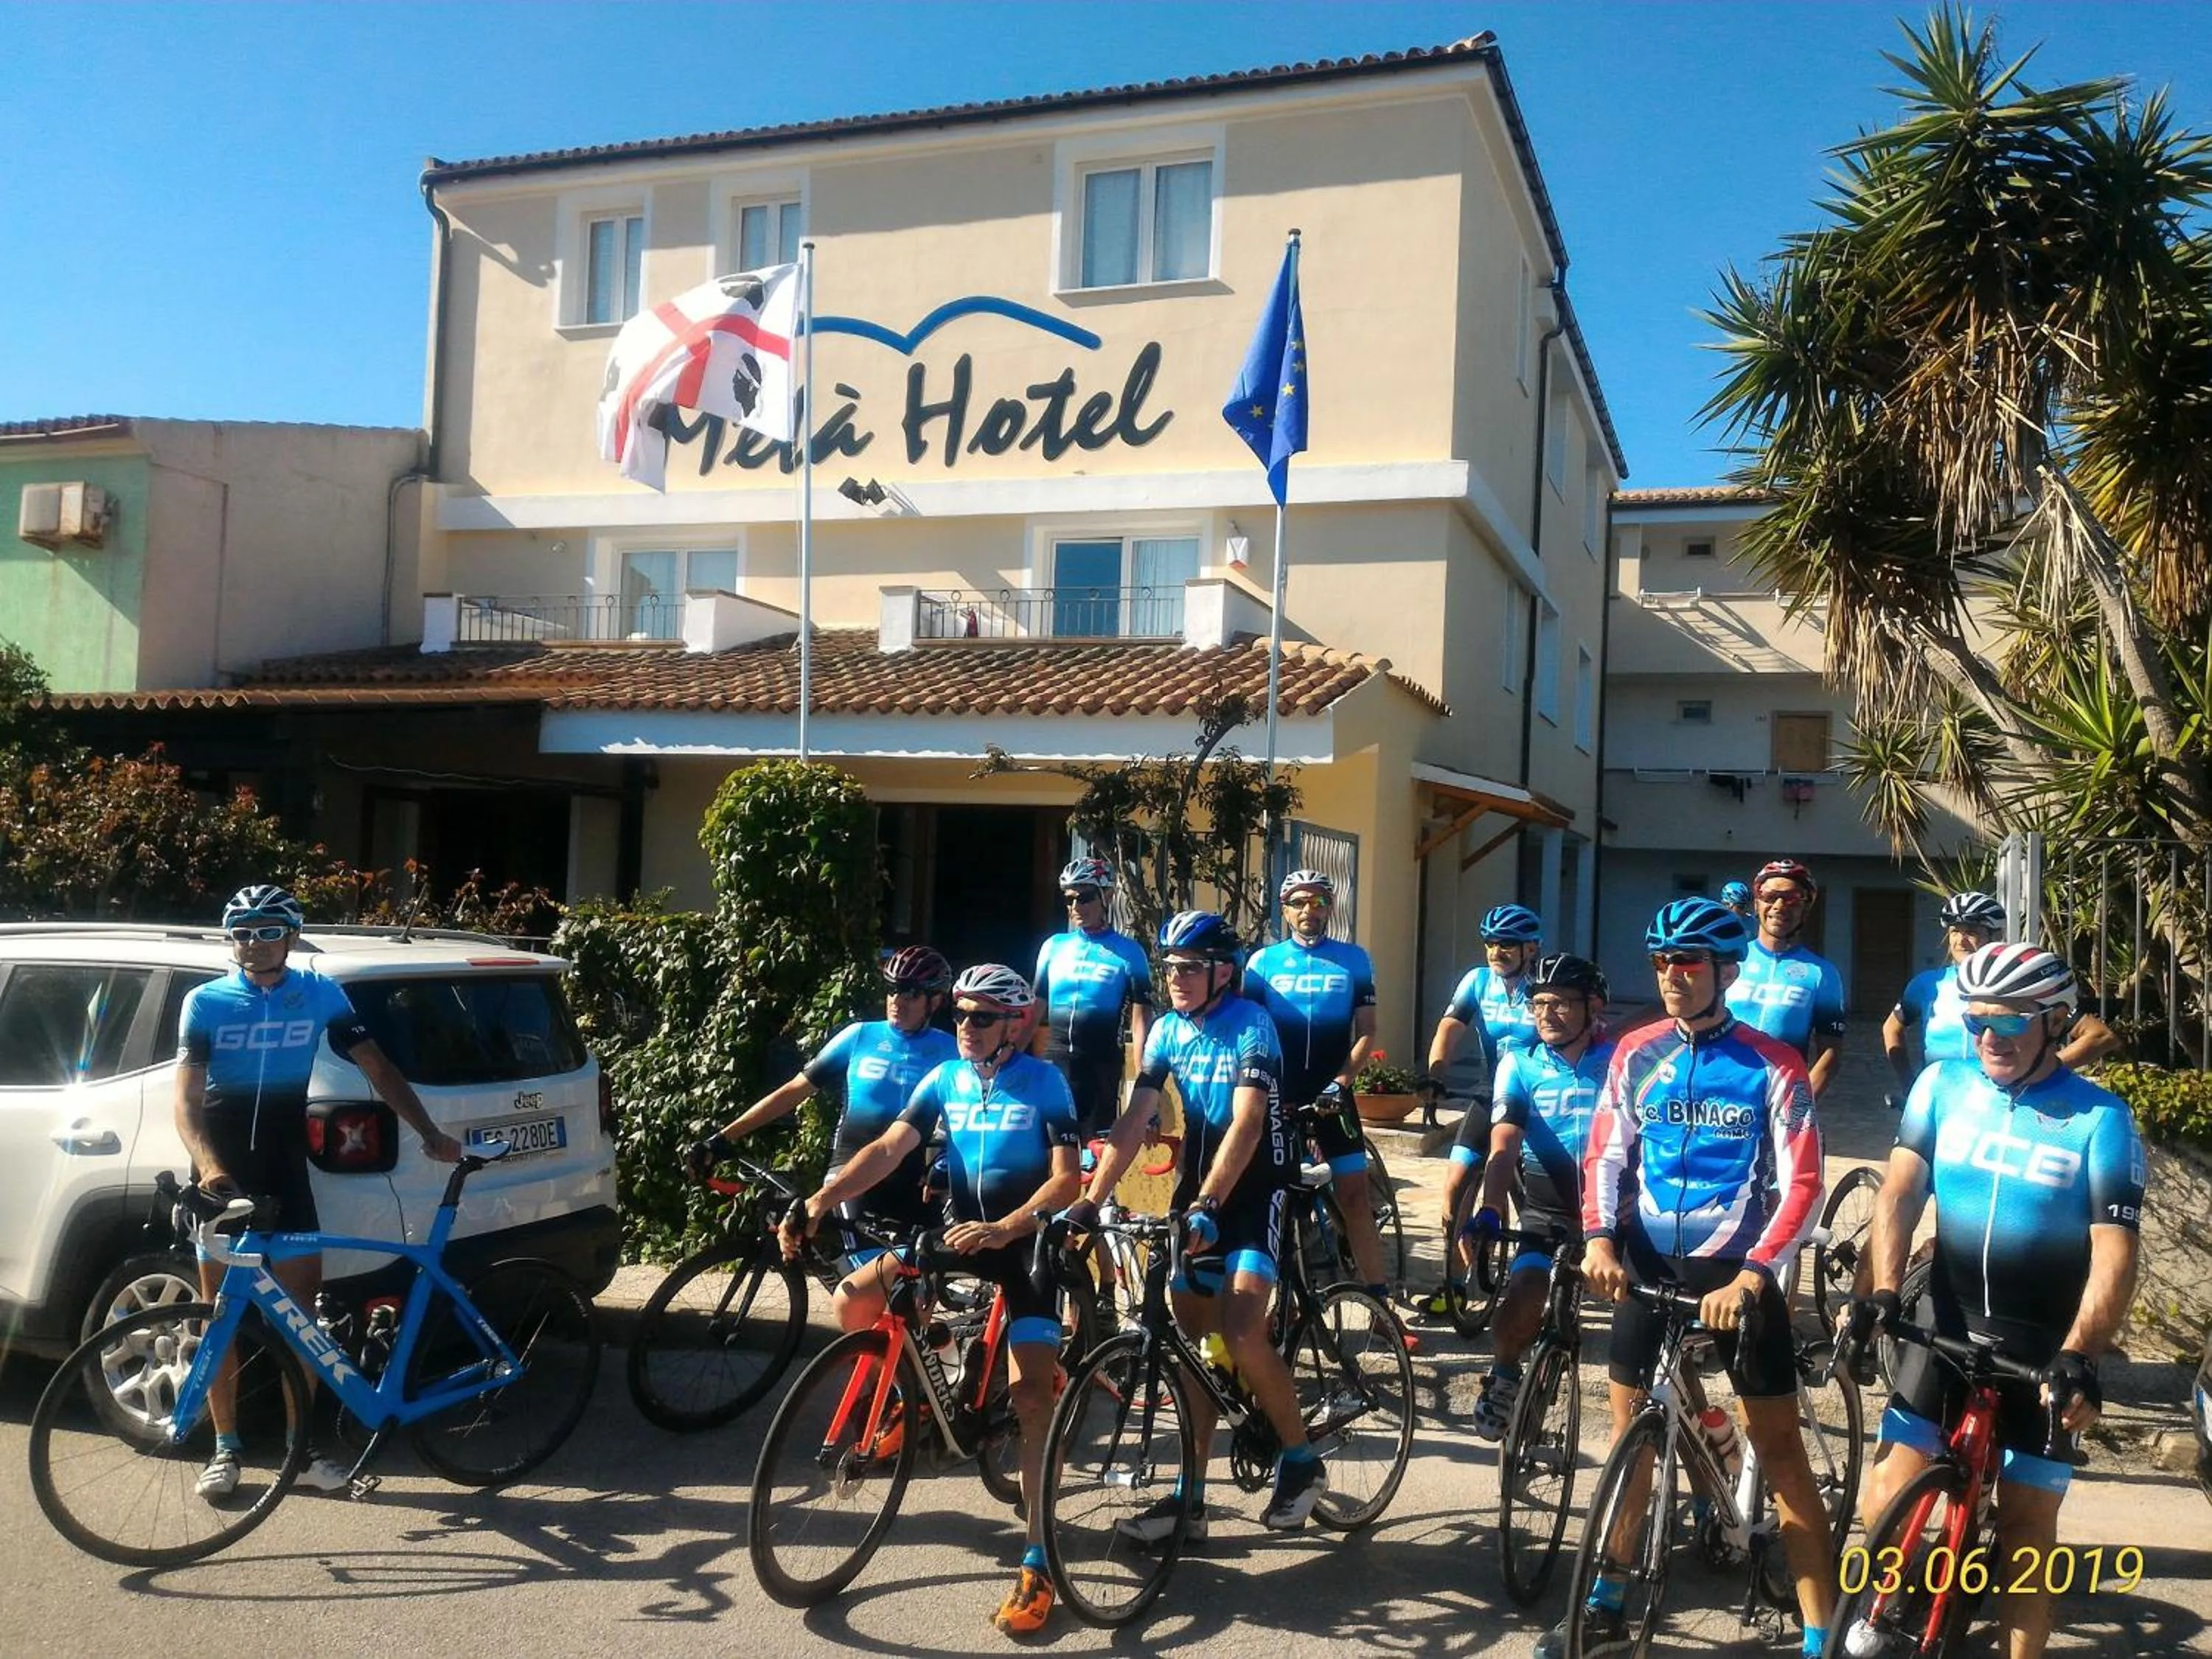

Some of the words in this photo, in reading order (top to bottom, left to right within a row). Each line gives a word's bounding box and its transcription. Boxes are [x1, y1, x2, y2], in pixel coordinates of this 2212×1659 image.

[901, 341, 1175, 467] Hotel
[215, 1020, 315, 1050] GCB
[857, 1056, 919, 1085] GC
[514, 1091, 543, 1109] Jeep
[1534, 1088, 1596, 1116] GC
[1668, 1099, 1756, 1127] BINAGO
[944, 1102, 1036, 1131] GCB
[254, 1266, 359, 1385] TREK
